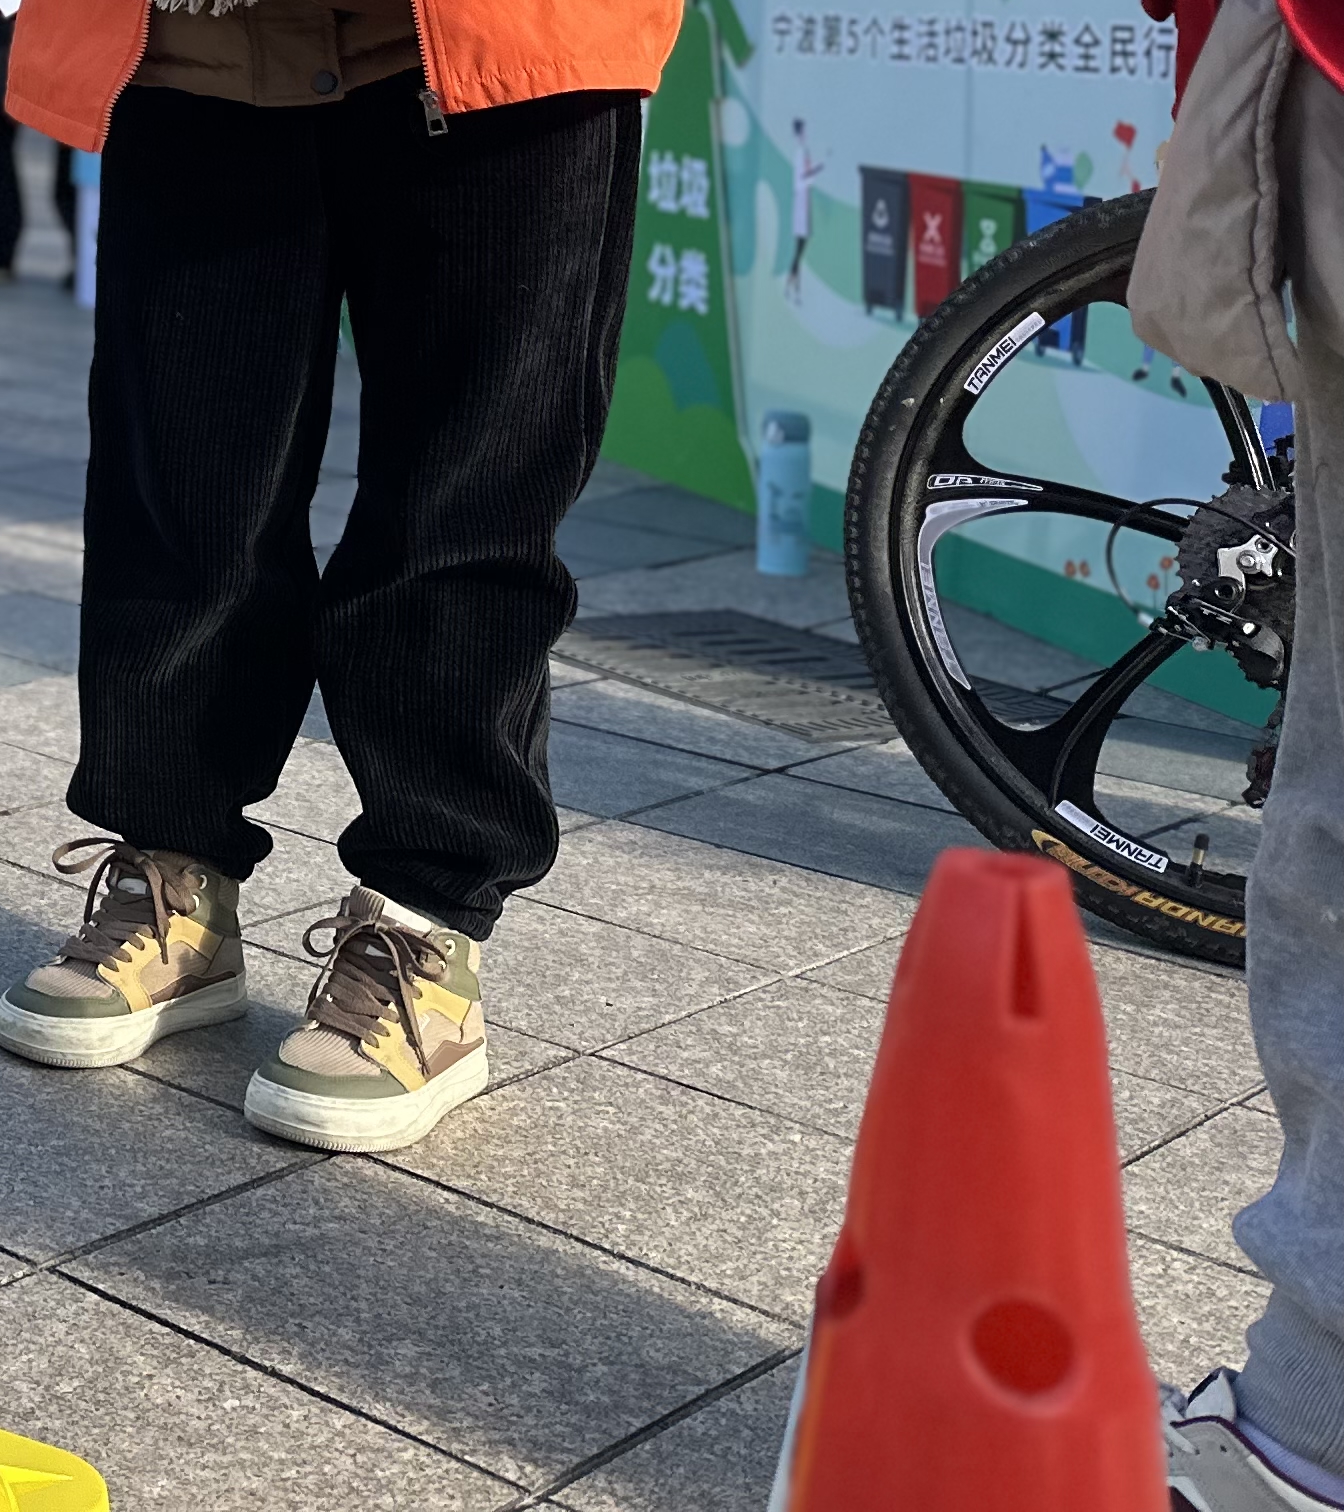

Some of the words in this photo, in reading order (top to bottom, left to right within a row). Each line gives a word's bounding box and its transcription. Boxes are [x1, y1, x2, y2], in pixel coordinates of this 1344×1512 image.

[771, 13, 1175, 80] 宁波第5个生活垃圾分类全民行
[646, 243, 709, 315] 分类
[967, 336, 1017, 391] TANMEI
[1090, 824, 1163, 870] TANMEI
